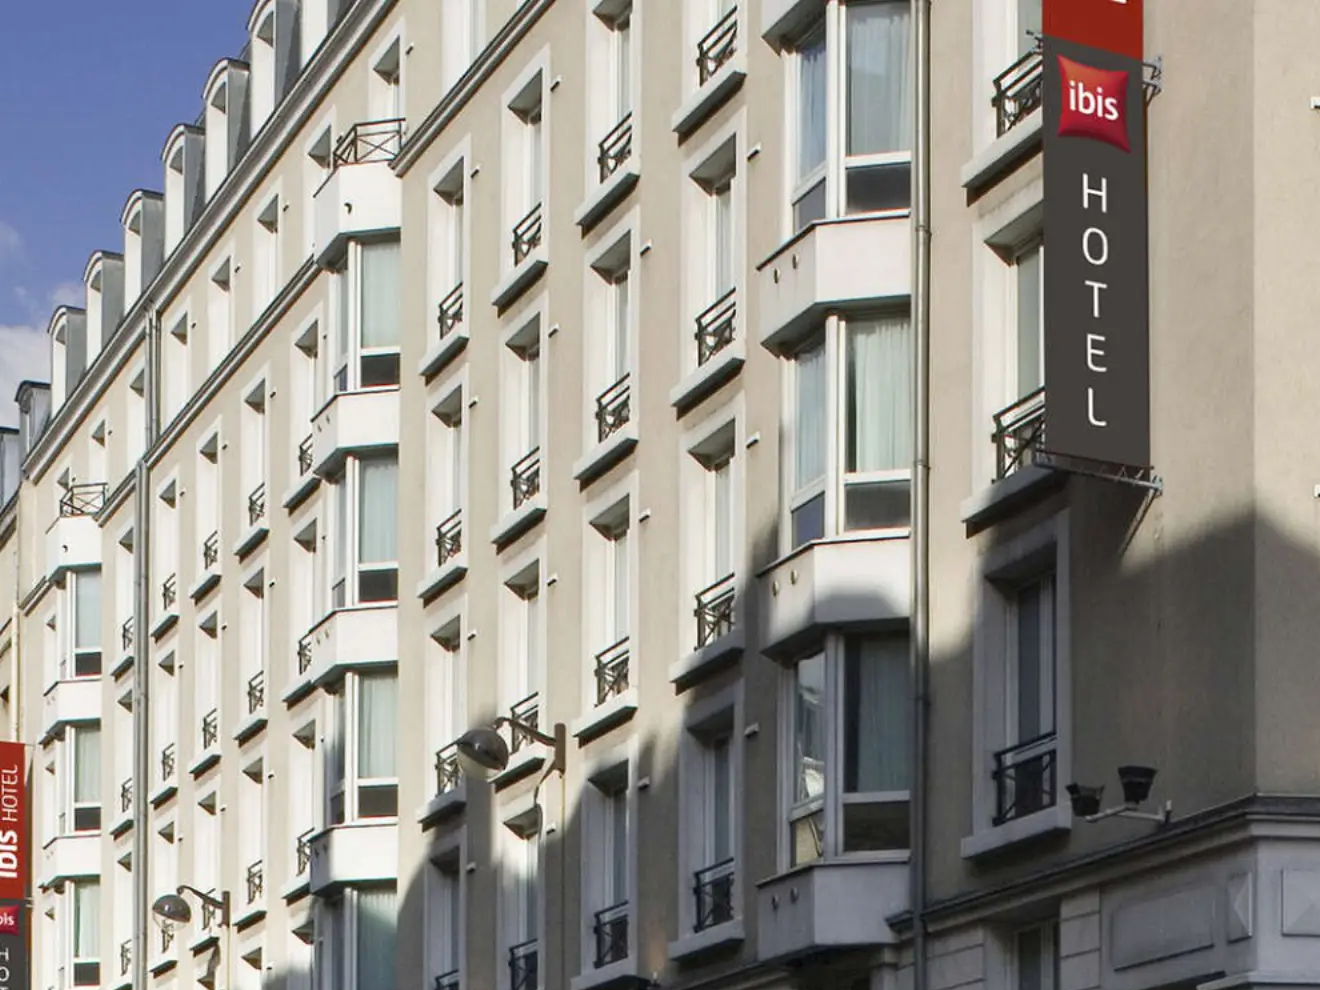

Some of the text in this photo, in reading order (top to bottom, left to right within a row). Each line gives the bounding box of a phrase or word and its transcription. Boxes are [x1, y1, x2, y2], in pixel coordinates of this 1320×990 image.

[1069, 80, 1118, 120] ibis
[1082, 173, 1108, 427] HOTEL
[1, 764, 18, 821] HOTEL
